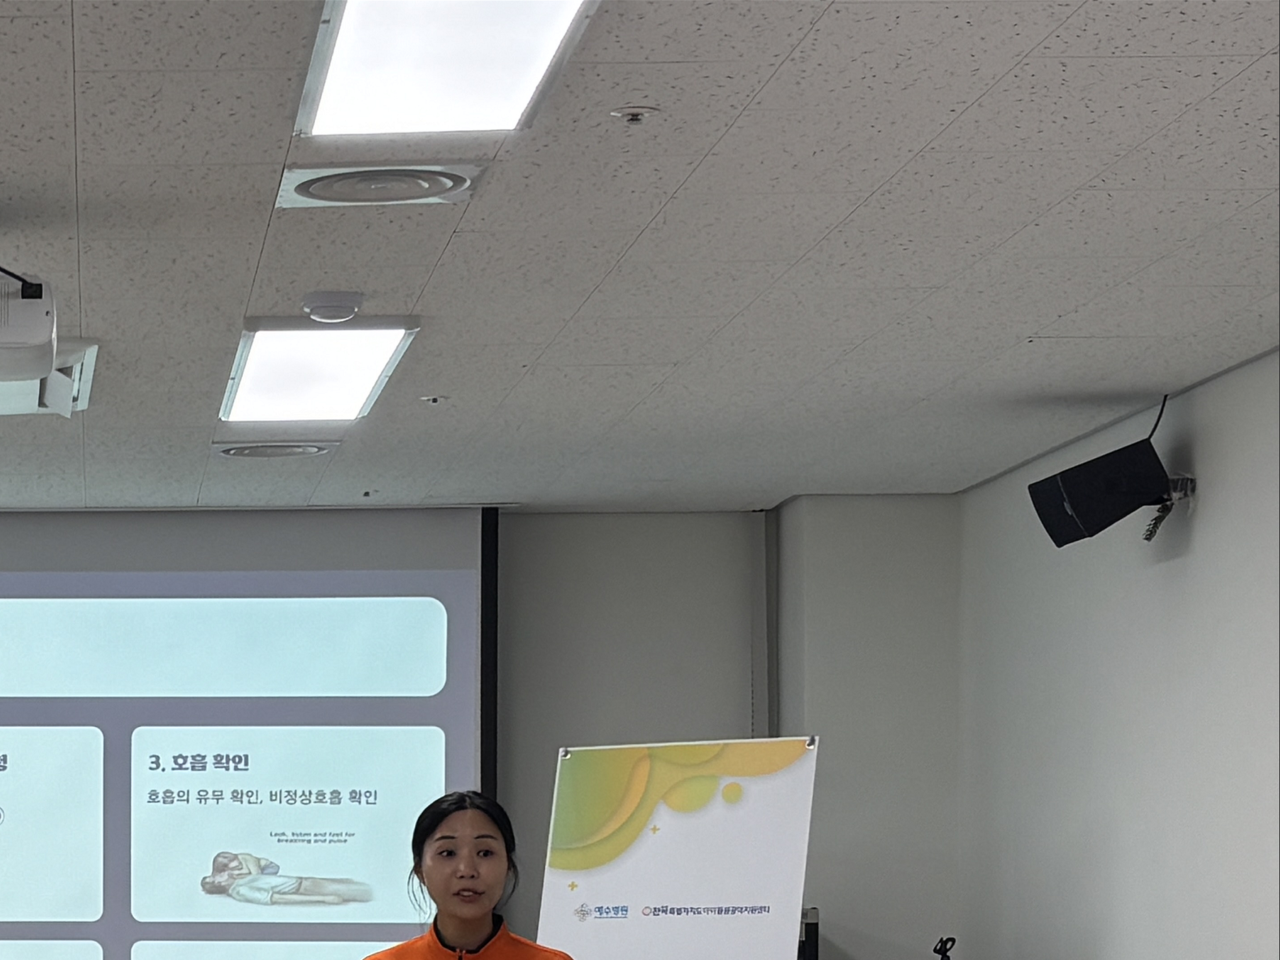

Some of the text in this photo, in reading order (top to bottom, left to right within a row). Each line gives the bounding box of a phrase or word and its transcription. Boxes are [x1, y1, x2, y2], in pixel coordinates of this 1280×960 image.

[148, 753, 250, 772] 3. 호흡 확인
[147, 789, 378, 805] 호흡의 유무 확인, 비정상호흡 확인
